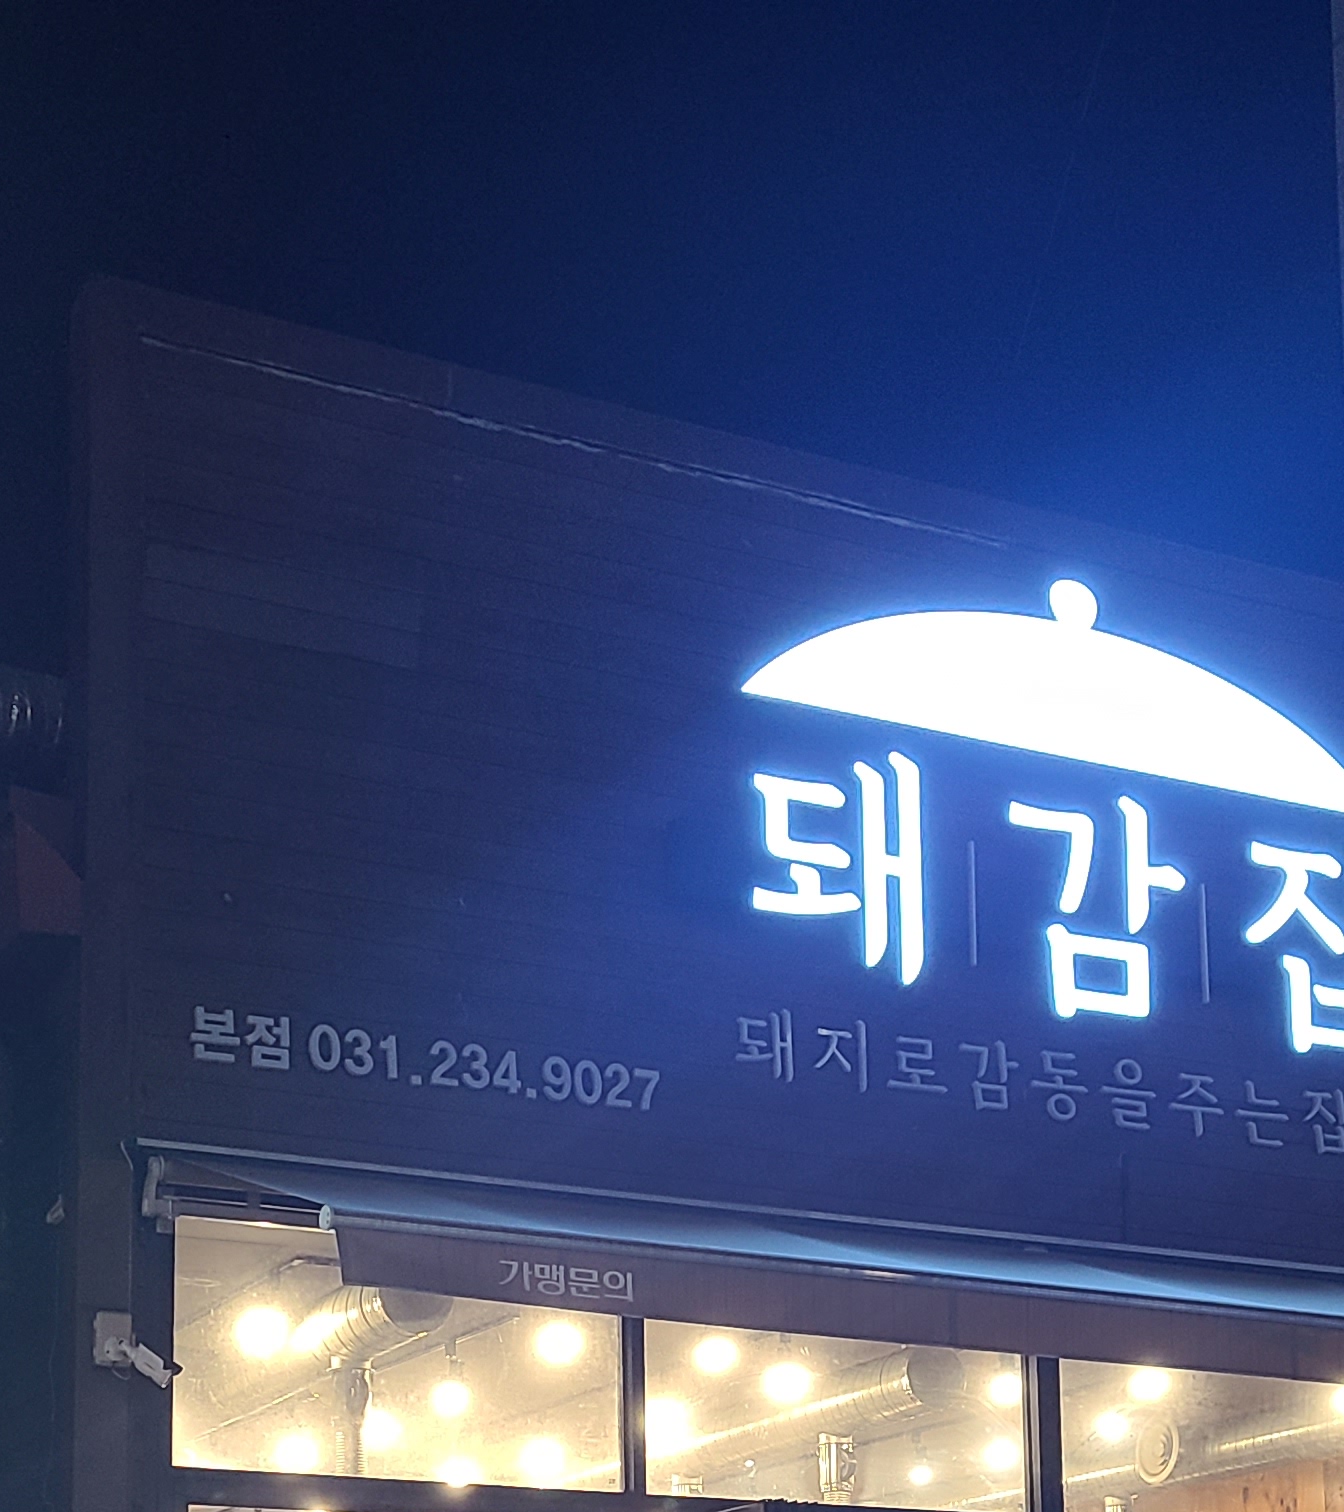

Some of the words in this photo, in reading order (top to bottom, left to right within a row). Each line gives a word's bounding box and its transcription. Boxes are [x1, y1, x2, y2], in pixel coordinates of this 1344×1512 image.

[189, 1004, 292, 1071] 본점
[307, 1021, 662, 1112] 031.234.9027
[497, 1257, 636, 1302] 가맹문의
